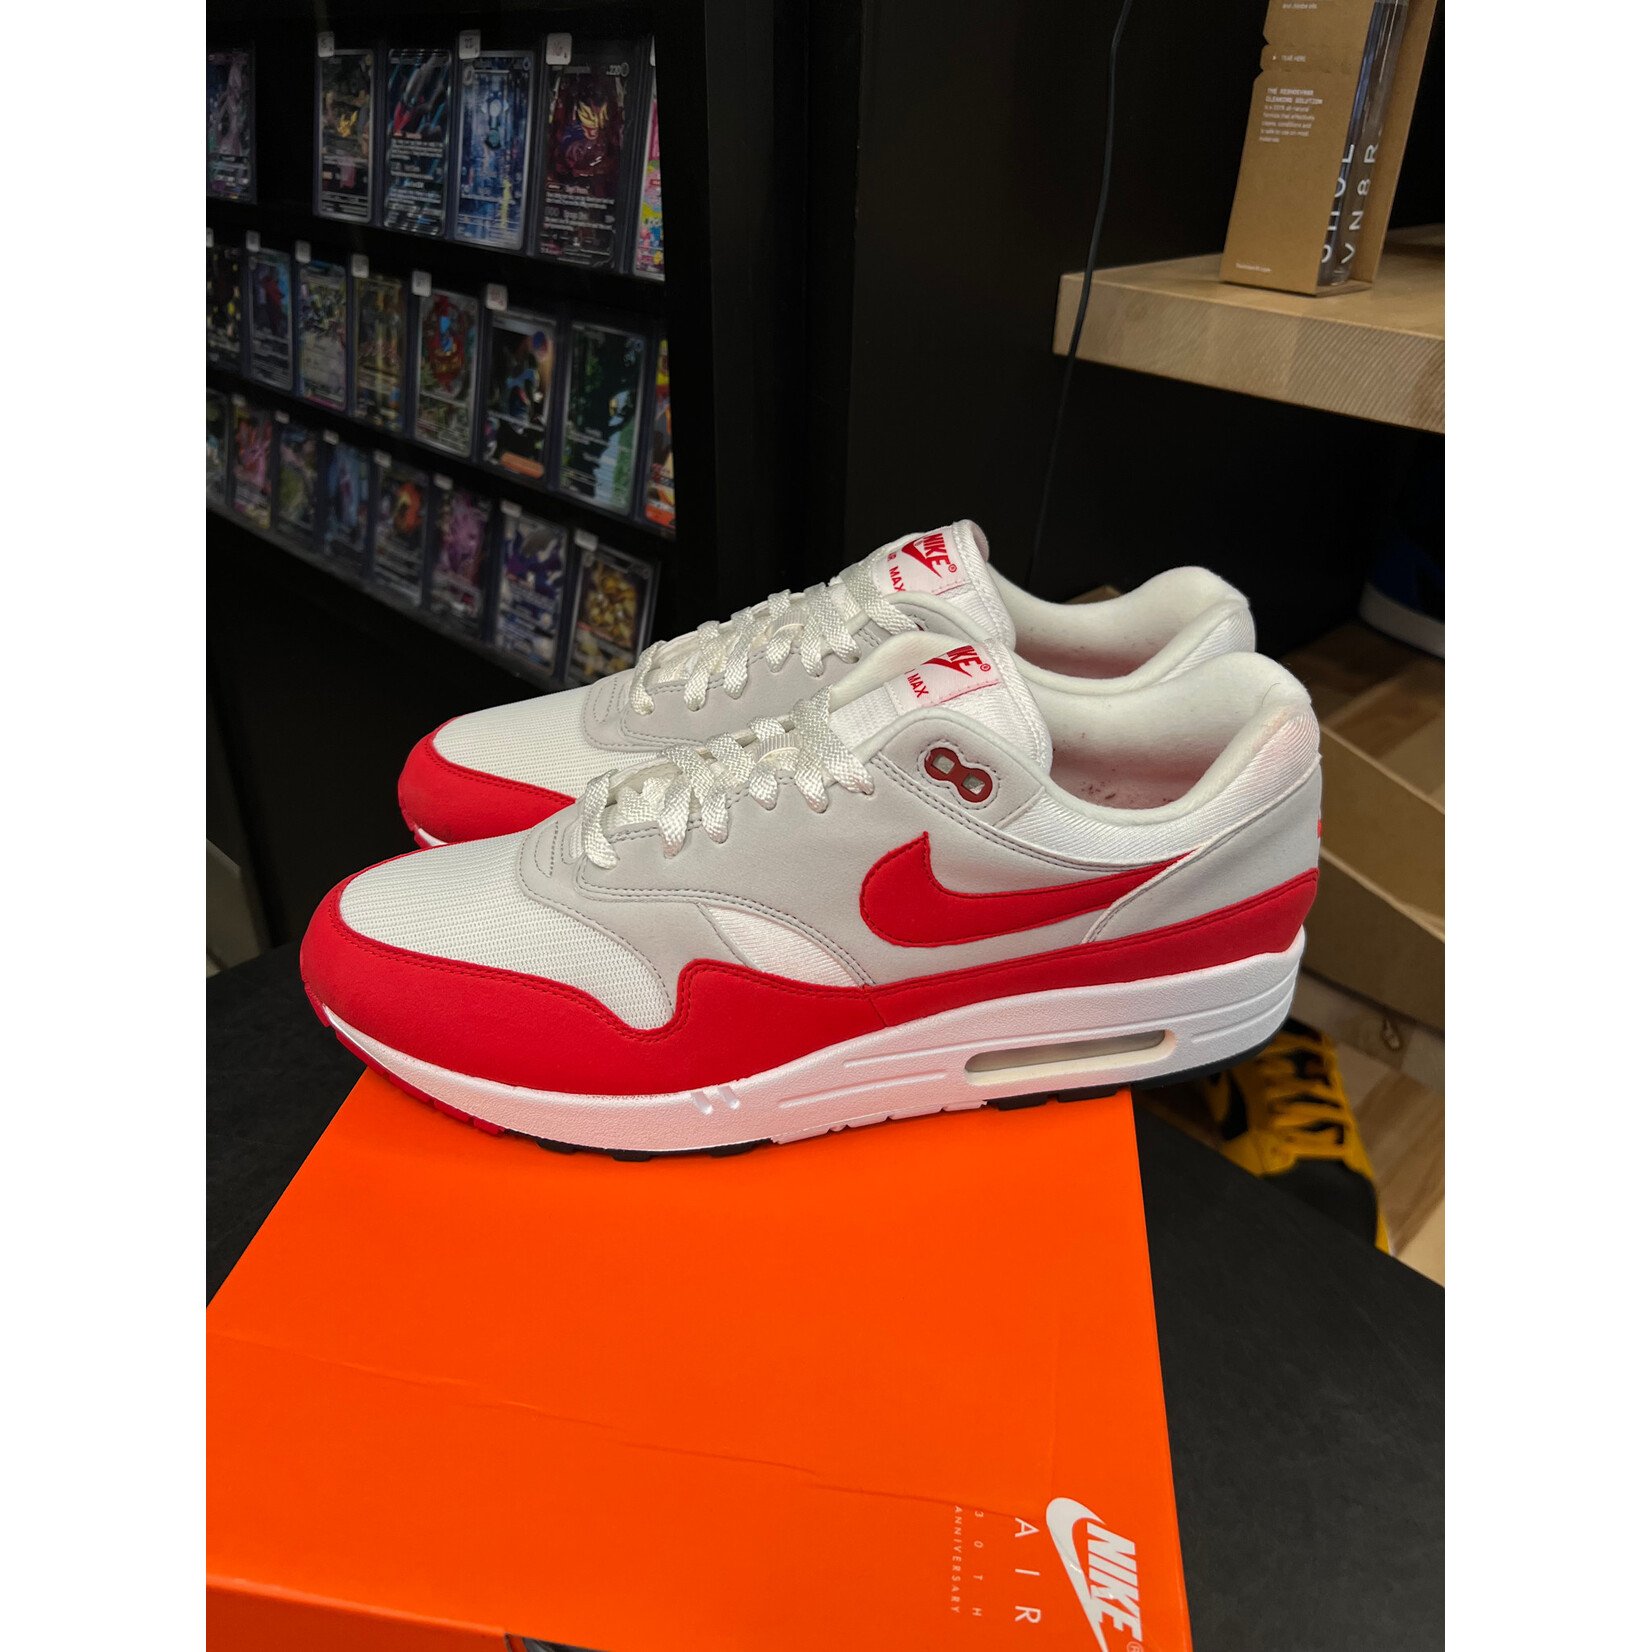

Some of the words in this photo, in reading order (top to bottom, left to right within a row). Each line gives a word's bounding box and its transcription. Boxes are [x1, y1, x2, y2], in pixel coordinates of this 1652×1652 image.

[1341, 143, 1379, 264] VN8R
[889, 565, 906, 592] MAX
[907, 672, 929, 698] MAX
[951, 1505, 963, 1614] ANNIVERSARY
[972, 1510, 984, 1617] 30TH
[1014, 1516, 1041, 1624] AIR
[1086, 1521, 1143, 1642] NIKE
